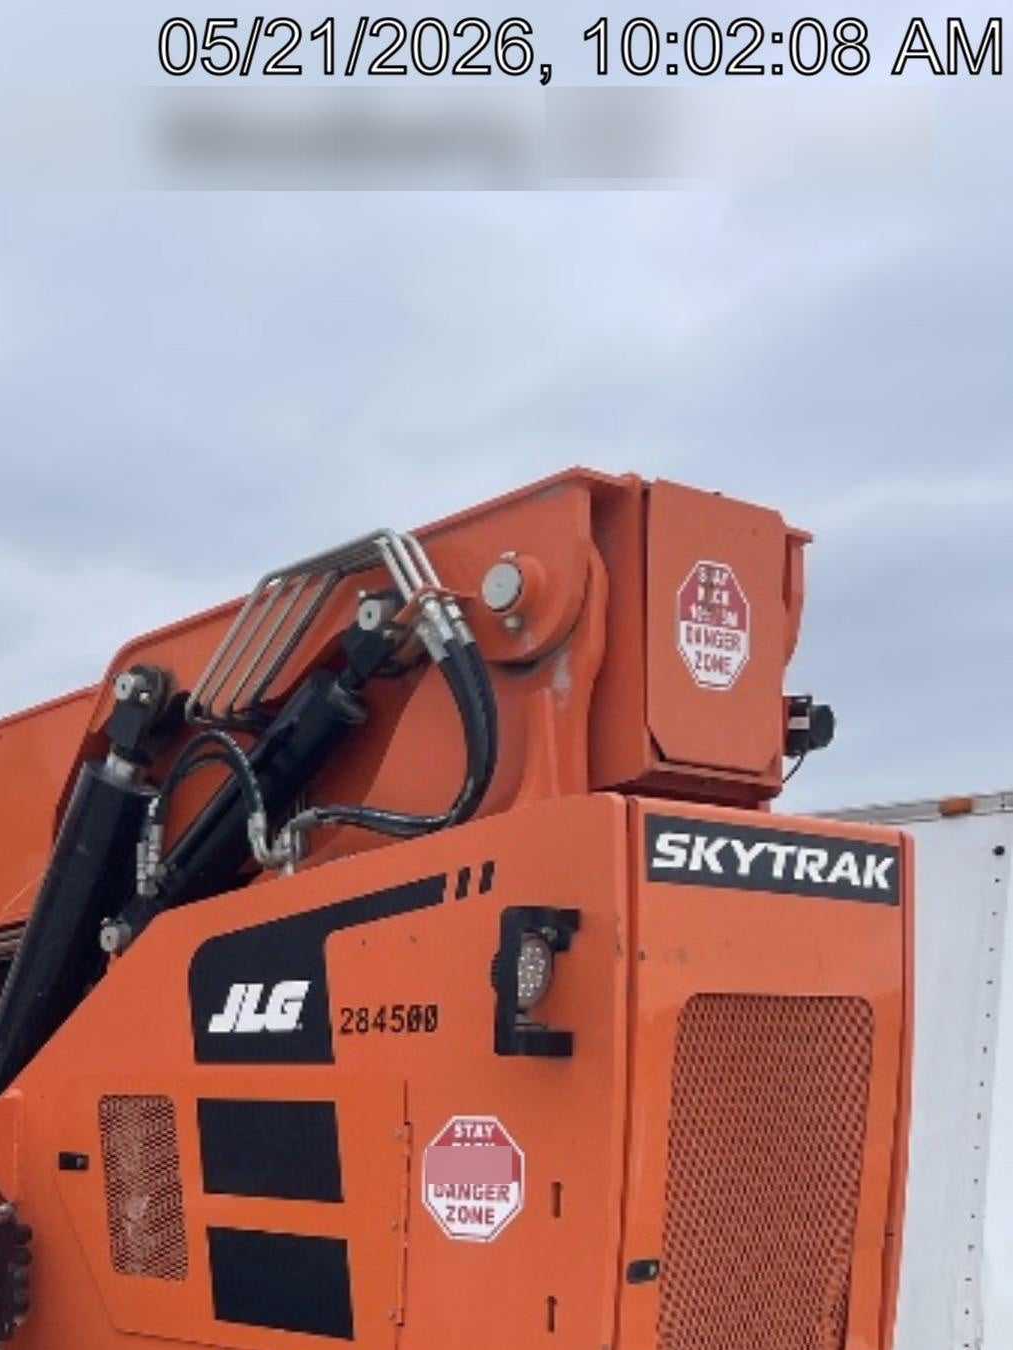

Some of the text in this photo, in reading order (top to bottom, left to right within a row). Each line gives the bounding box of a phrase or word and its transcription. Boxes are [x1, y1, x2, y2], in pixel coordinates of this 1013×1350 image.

[652, 831, 895, 889] SKYTRAK
[207, 980, 312, 1034] JLG
[454, 1122, 496, 1139] STAY
[434, 1183, 511, 1203] DANGER
[446, 1205, 495, 1226] ZONE
